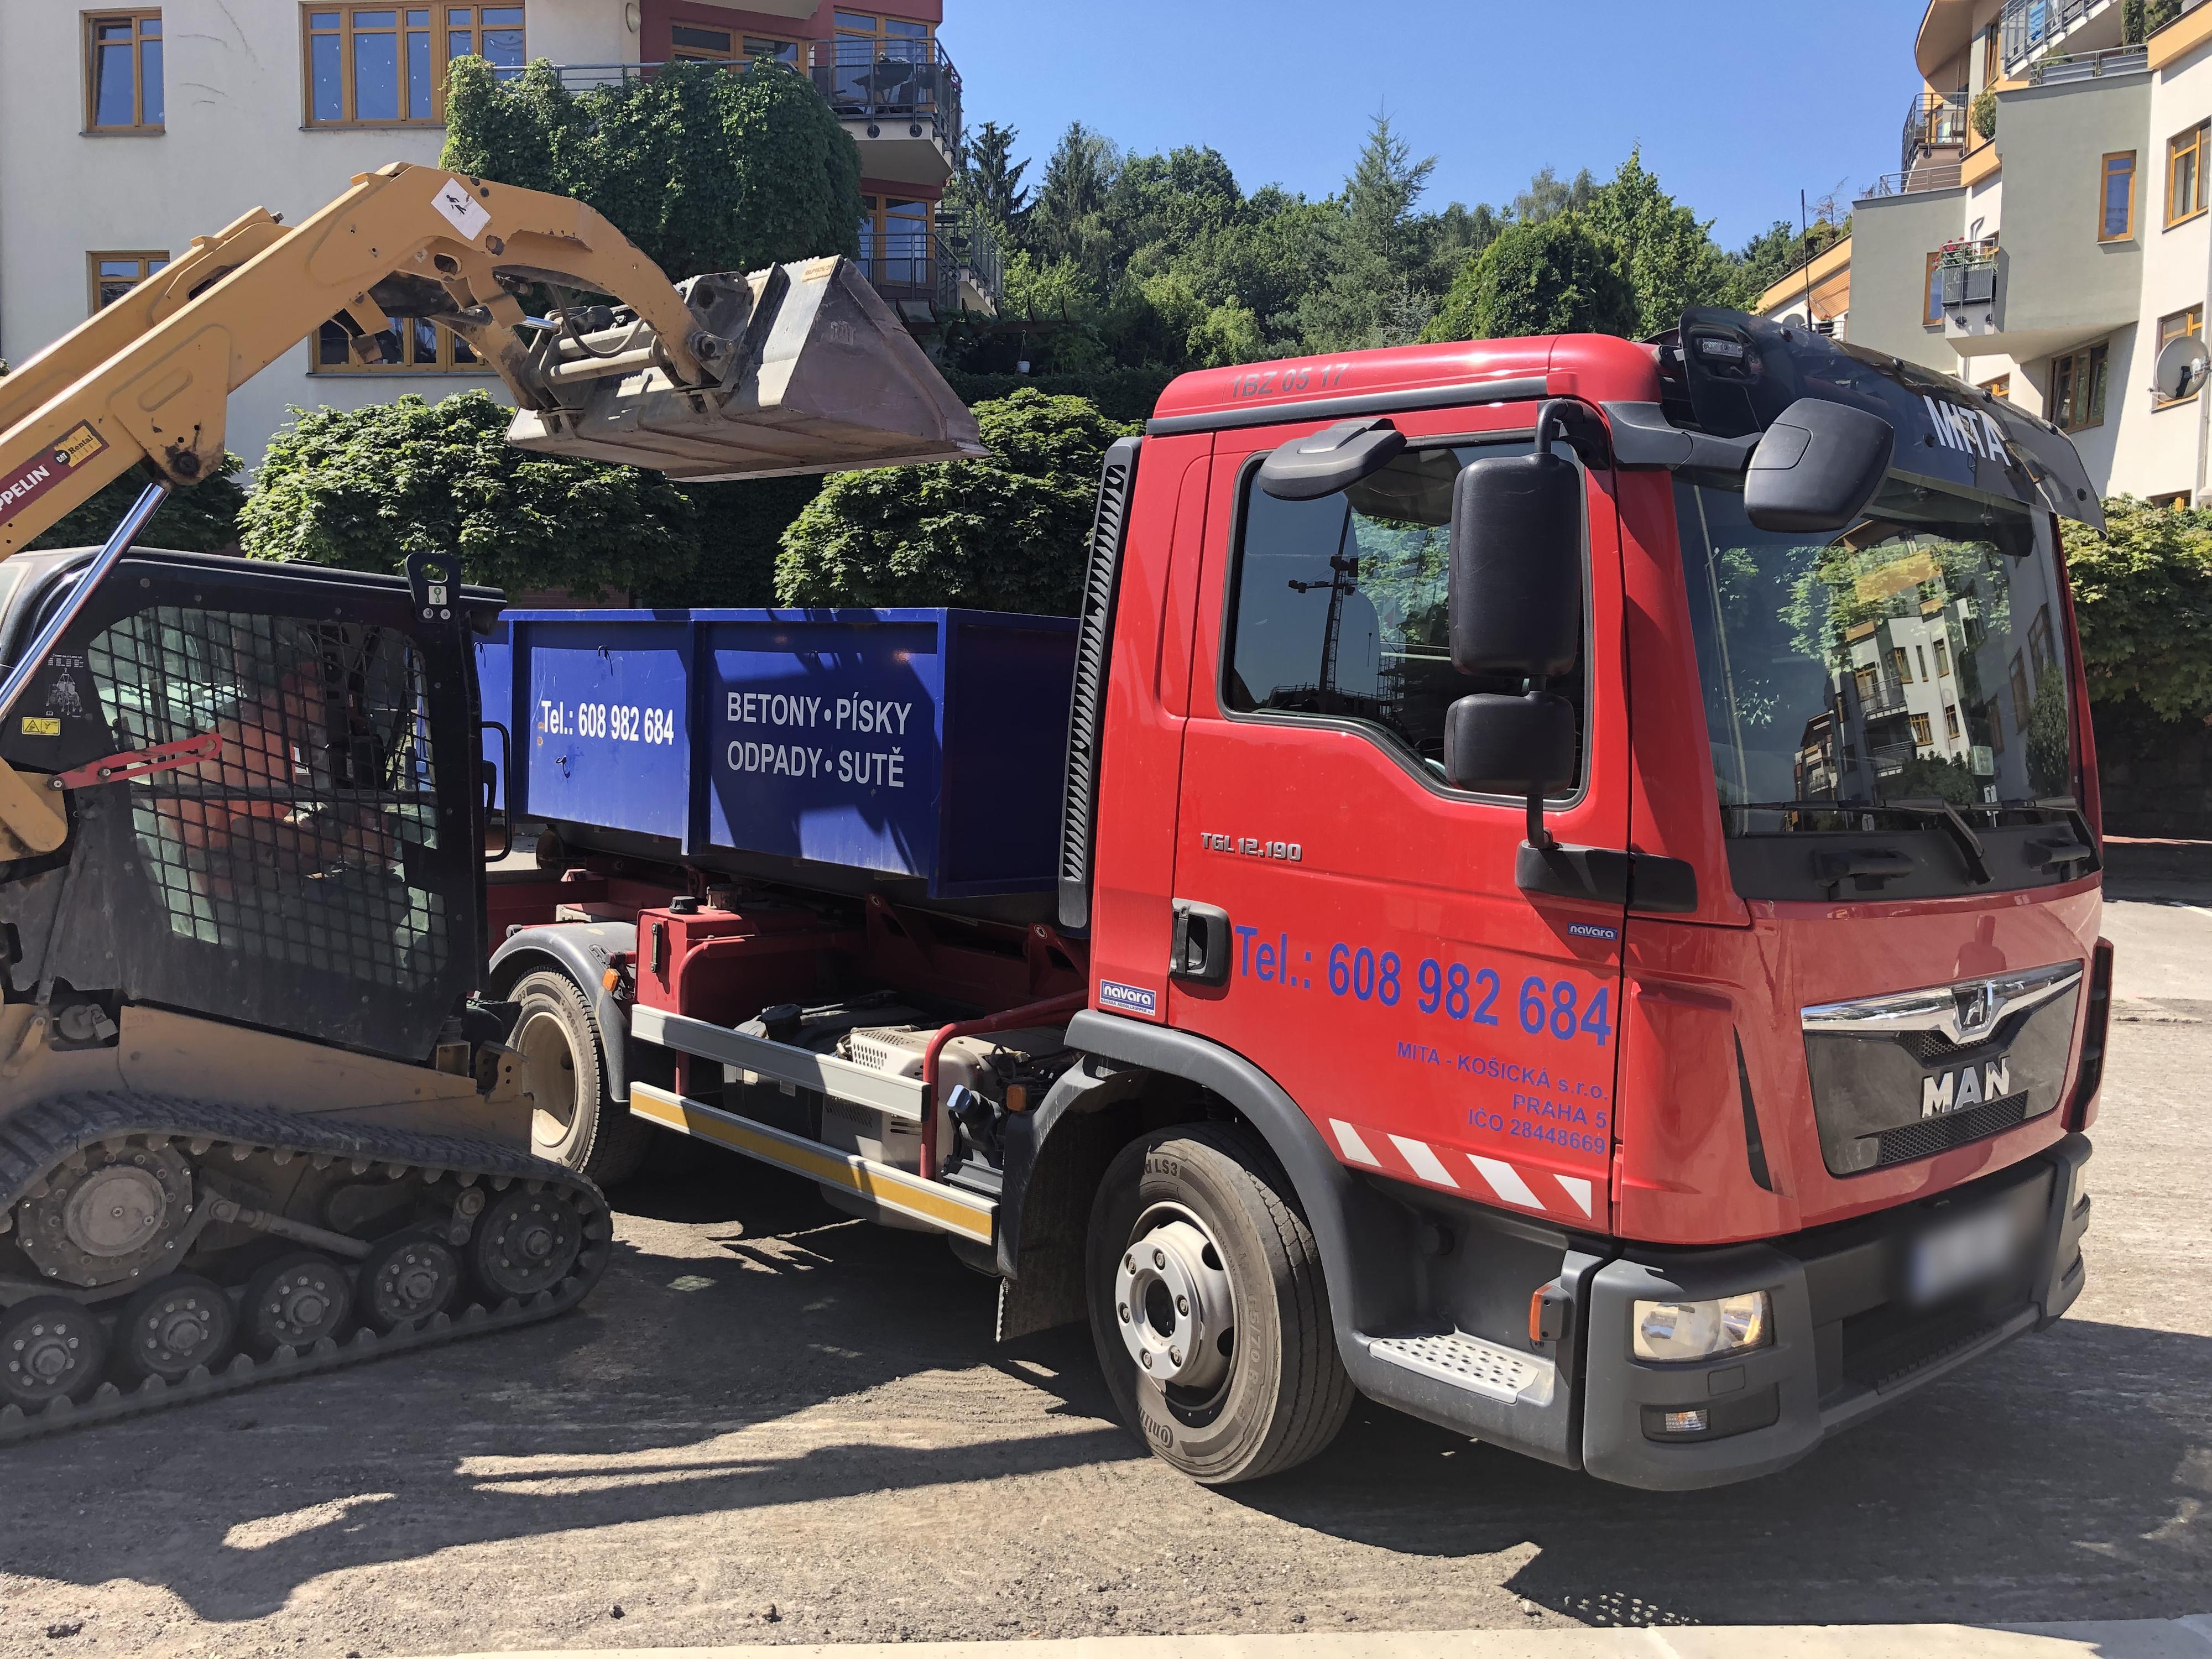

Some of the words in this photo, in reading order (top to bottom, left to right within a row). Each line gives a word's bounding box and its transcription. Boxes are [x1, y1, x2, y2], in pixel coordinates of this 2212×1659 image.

[1233, 371, 1277, 398] 1BZ
[1282, 367, 1313, 392] 05
[1321, 363, 1350, 387] 17
[56, 452, 68, 463] CAT
[67, 435, 93, 455] Rental
[1923, 394, 2012, 467] MITA
[541, 700, 573, 735] Tel.:
[578, 702, 606, 738] 608
[611, 705, 639, 742] 982
[644, 707, 674, 745] 684
[727, 692, 822, 727] BETONY
[836, 691, 912, 735] PÍSKY
[727, 740, 823, 778] ODPADY
[838, 747, 904, 787] SUTĚ
[1200, 832, 1235, 853] TGL
[1238, 837, 1302, 861] 12.190
[1570, 925, 1614, 938] navara
[1104, 985, 1151, 1005] navara
[1235, 925, 1311, 989] Tel.:
[1328, 942, 1401, 1006] 608
[1417, 958, 1500, 1026] 982
[1519, 975, 1611, 1046] 684
[1397, 1041, 1440, 1066] MITA
[1457, 1053, 1550, 1088] KOŠICKÁ
[1558, 1078, 1608, 1099] s.r.o.
[1922, 1055, 2010, 1119] MAN
[1468, 1107, 1504, 1131] IČO
[1510, 1118, 1605, 1155] 28448669
[1512, 1093, 1588, 1124] PRAHA
[1595, 1110, 1606, 1128] 5
[1155, 1158, 1177, 1177] LS3
